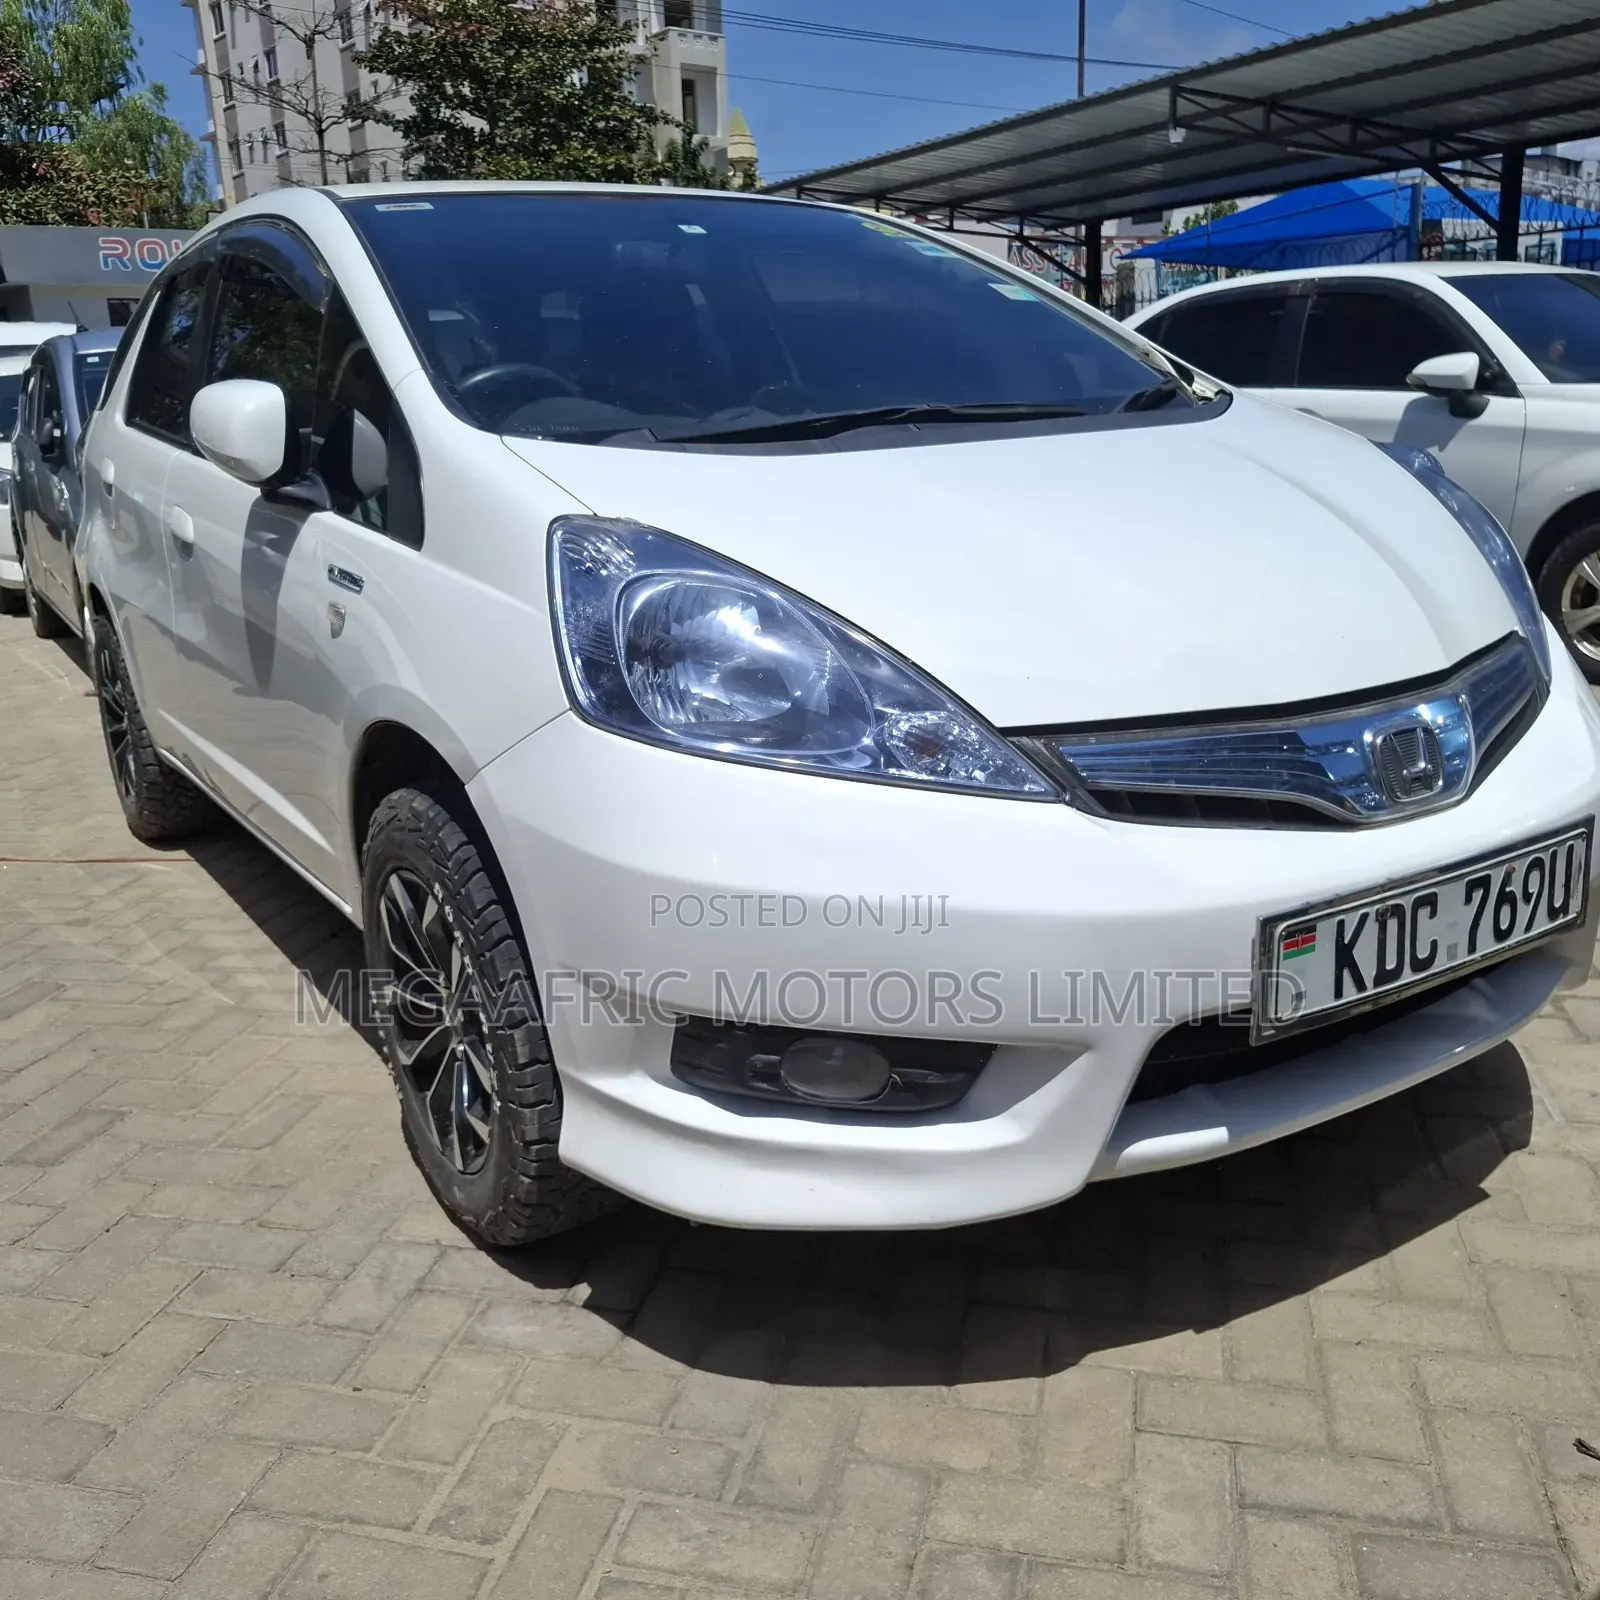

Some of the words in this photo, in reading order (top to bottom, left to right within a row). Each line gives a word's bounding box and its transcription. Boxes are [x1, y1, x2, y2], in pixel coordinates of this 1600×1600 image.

[98, 236, 186, 271] RO
[1334, 891, 1438, 1000] KDC
[1464, 842, 1575, 955] 769U
